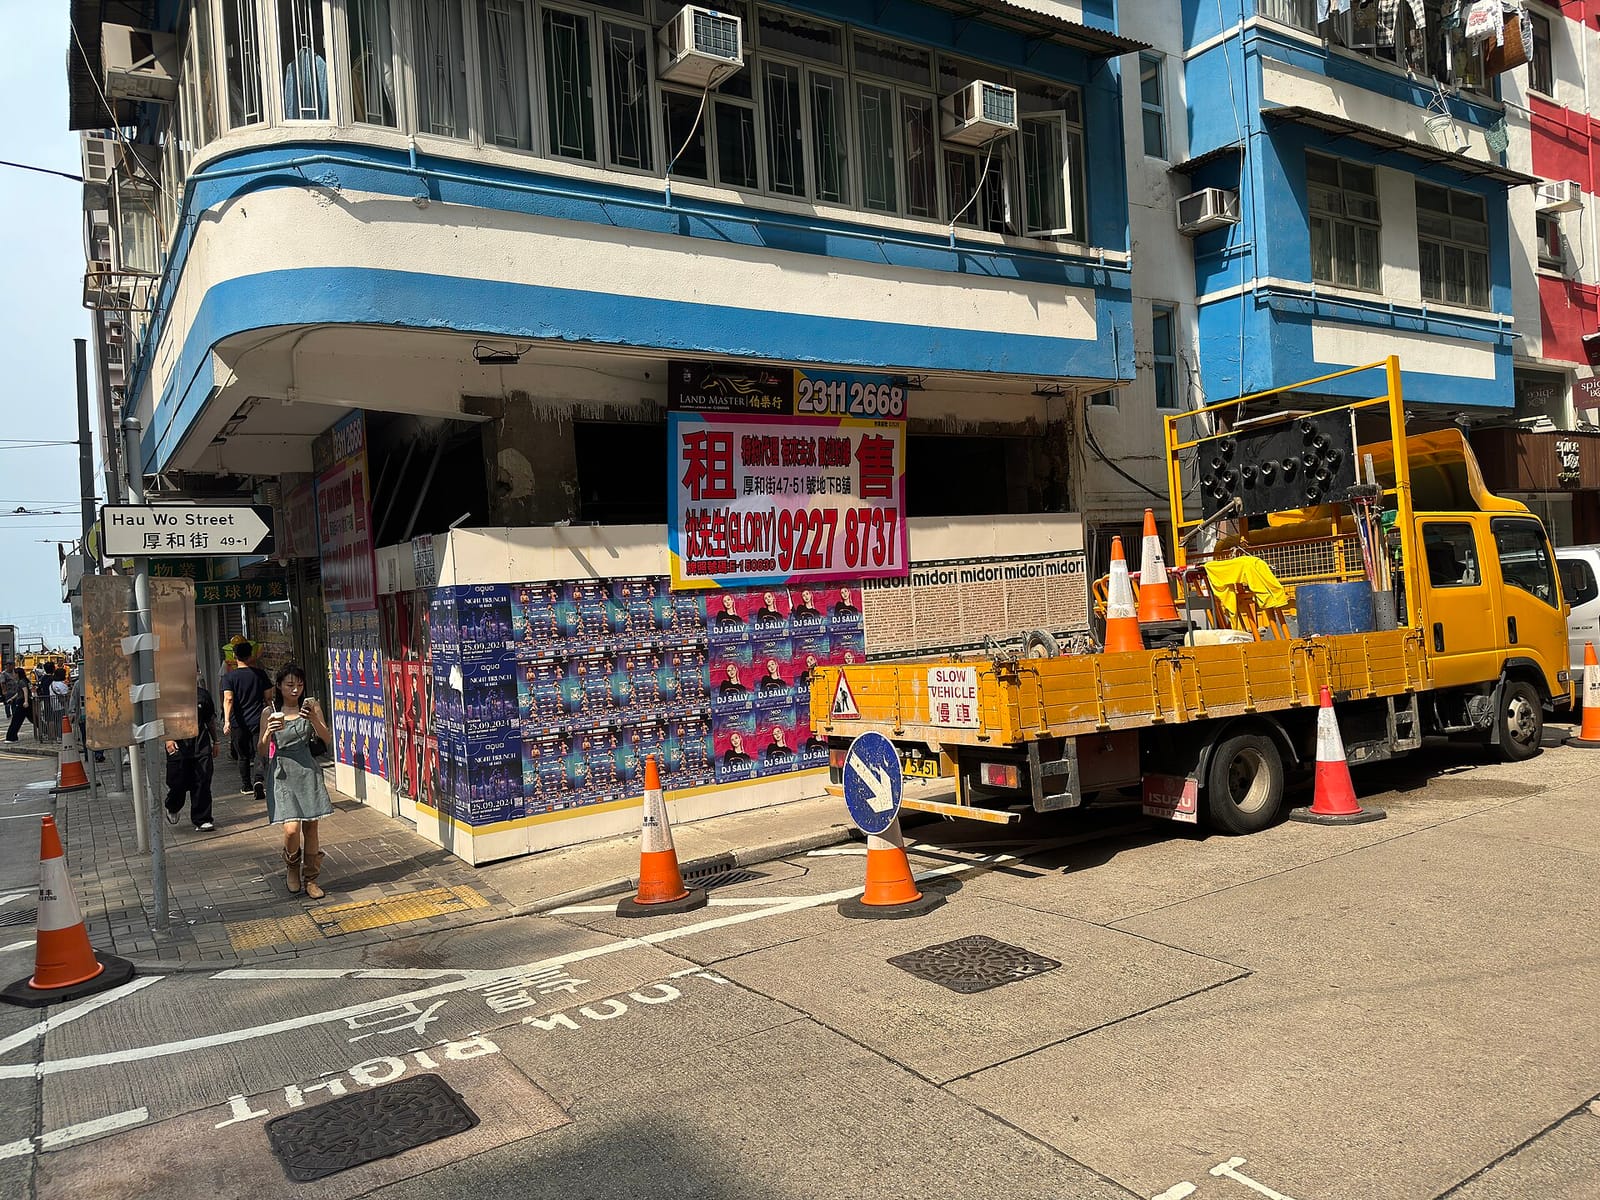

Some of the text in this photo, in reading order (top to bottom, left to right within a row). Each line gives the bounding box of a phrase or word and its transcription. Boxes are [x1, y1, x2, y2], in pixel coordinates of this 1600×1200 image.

[680, 393, 705, 404] LAND
[708, 396, 745, 406] MASTER
[798, 380, 903, 416] 2311 2668
[1556, 438, 1580, 458] spice
[682, 430, 736, 501] 租
[855, 434, 894, 500] 售
[112, 514, 234, 526] Hau Wo Street
[143, 532, 208, 550] 厚和街
[778, 508, 838, 572] 9227
[844, 507, 898, 568] 8737
[913, 568, 958, 586] midori
[961, 566, 1002, 584] midori
[1004, 562, 1044, 580] midori
[1046, 558, 1084, 576] midori
[203, 580, 284, 601] 環球物業
[475, 586, 494, 596] aqua
[794, 618, 822, 628] DJ SALLY
[832, 614, 860, 624] DJ SALLY
[713, 625, 744, 634] DJ SALLY
[765, 621, 785, 630] SALLY
[480, 664, 500, 674] aqua
[936, 670, 966, 682] SLOW
[758, 688, 790, 699] DJ SALLY
[798, 686, 807, 694] DJ
[932, 686, 976, 698] VEHICLE
[717, 694, 748, 704] DJ SALLY
[936, 702, 971, 724] 慢車
[468, 720, 510, 731] 25.09.2024
[485, 742, 504, 754] aqua
[774, 756, 794, 766] SALLY
[804, 752, 812, 760] DJ
[722, 762, 753, 774] DJ SALLY
[471, 799, 513, 810] 25.09.2024
[1149, 792, 1191, 808] ISUZU
[215, 1029, 502, 1129] RIGHT
